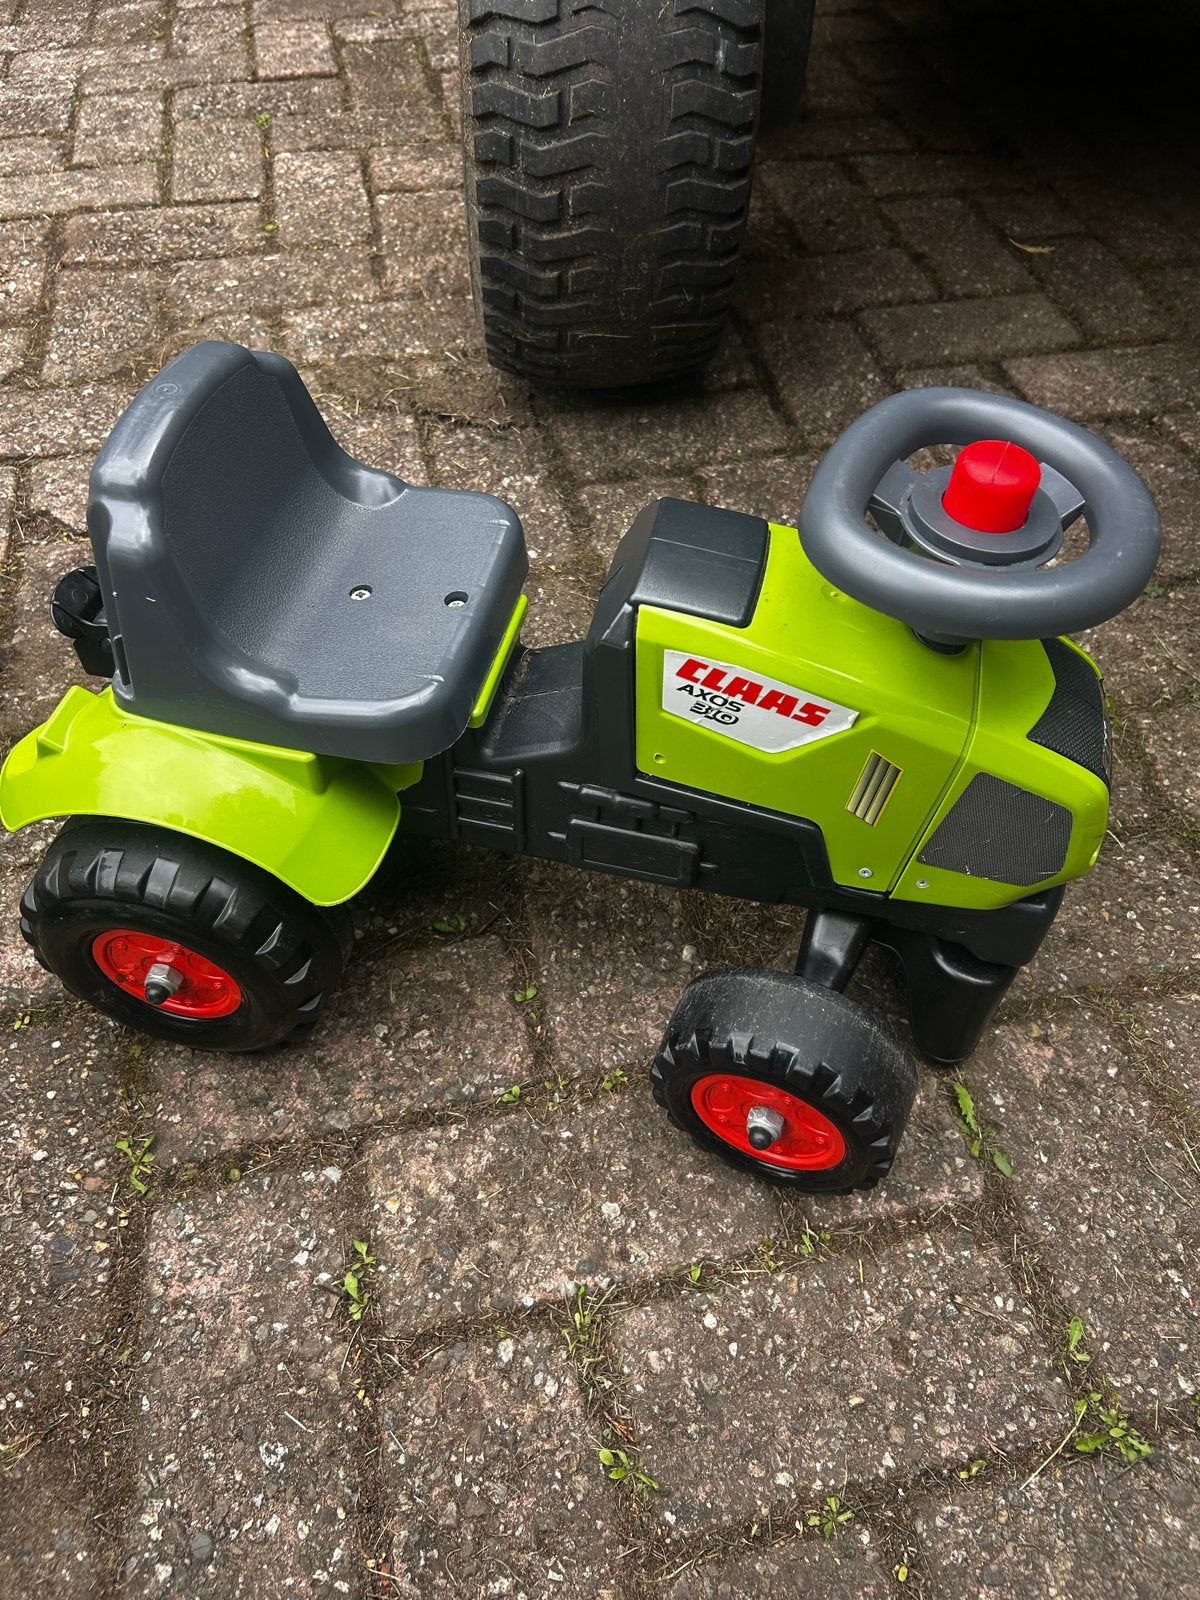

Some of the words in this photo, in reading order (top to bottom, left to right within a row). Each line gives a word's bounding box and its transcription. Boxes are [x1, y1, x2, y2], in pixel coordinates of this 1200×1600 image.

[675, 658, 832, 727] CLAAS
[676, 684, 745, 713] AXOS
[689, 701, 739, 725] 310
